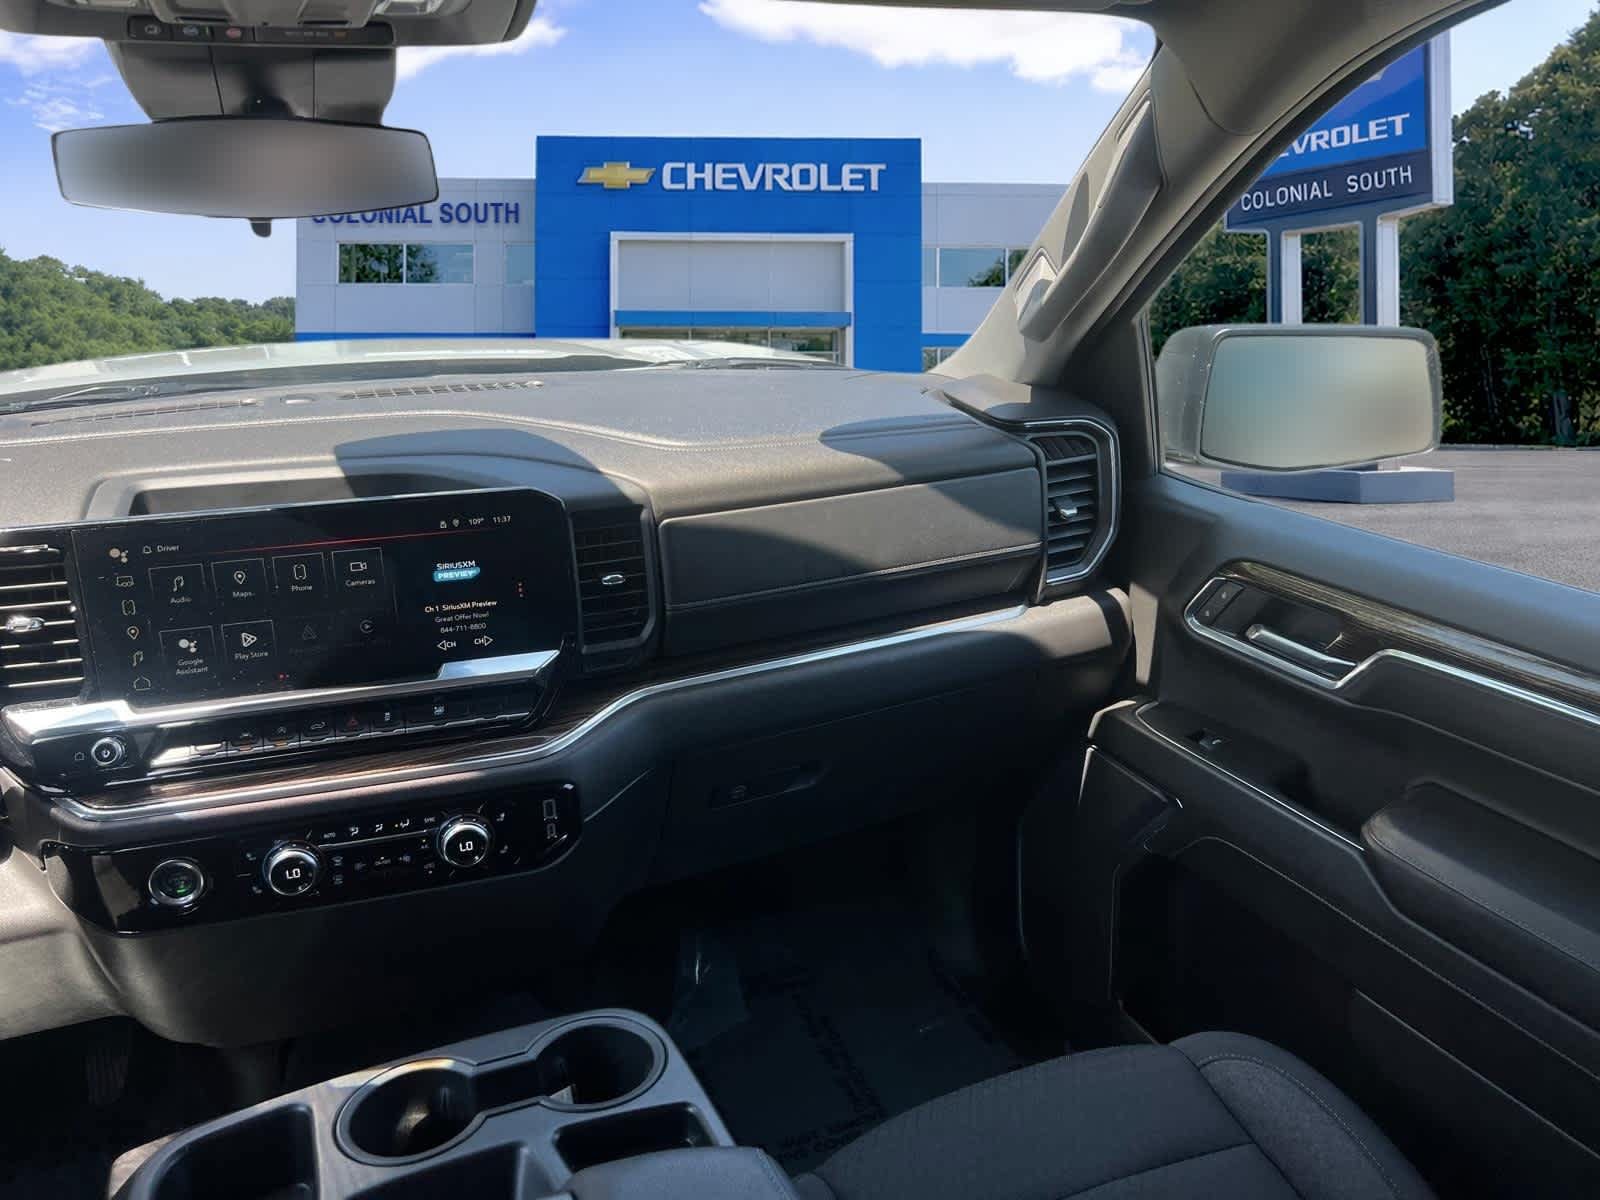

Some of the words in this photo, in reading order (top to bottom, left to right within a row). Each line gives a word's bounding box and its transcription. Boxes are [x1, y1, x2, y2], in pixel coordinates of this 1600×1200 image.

[662, 162, 887, 191] CHEVROLET
[1240, 180, 1333, 211] COLONIAL
[1347, 165, 1412, 193] SOUTH
[439, 202, 520, 224] SOUTH
[492, 515, 511, 524] 11:37
[156, 544, 180, 553] Driver
[436, 560, 476, 571] SIRIUSXM
[438, 570, 474, 580] PREVIEW
[291, 584, 313, 593] Phone
[345, 579, 376, 588] Cameras
[232, 591, 253, 599] Maps
[424, 605, 434, 613] Ch
[442, 602, 471, 612] SiriusXM
[471, 600, 498, 609] Preview
[434, 615, 454, 623] Great
[454, 613, 472, 621] Offer
[440, 622, 487, 634] 844-711-8800
[446, 640, 457, 648] CH
[474, 637, 485, 645] CH
[234, 652, 249, 661] Play
[250, 650, 269, 659] Store
[177, 657, 204, 667] Google
[175, 666, 209, 676] Assistant
